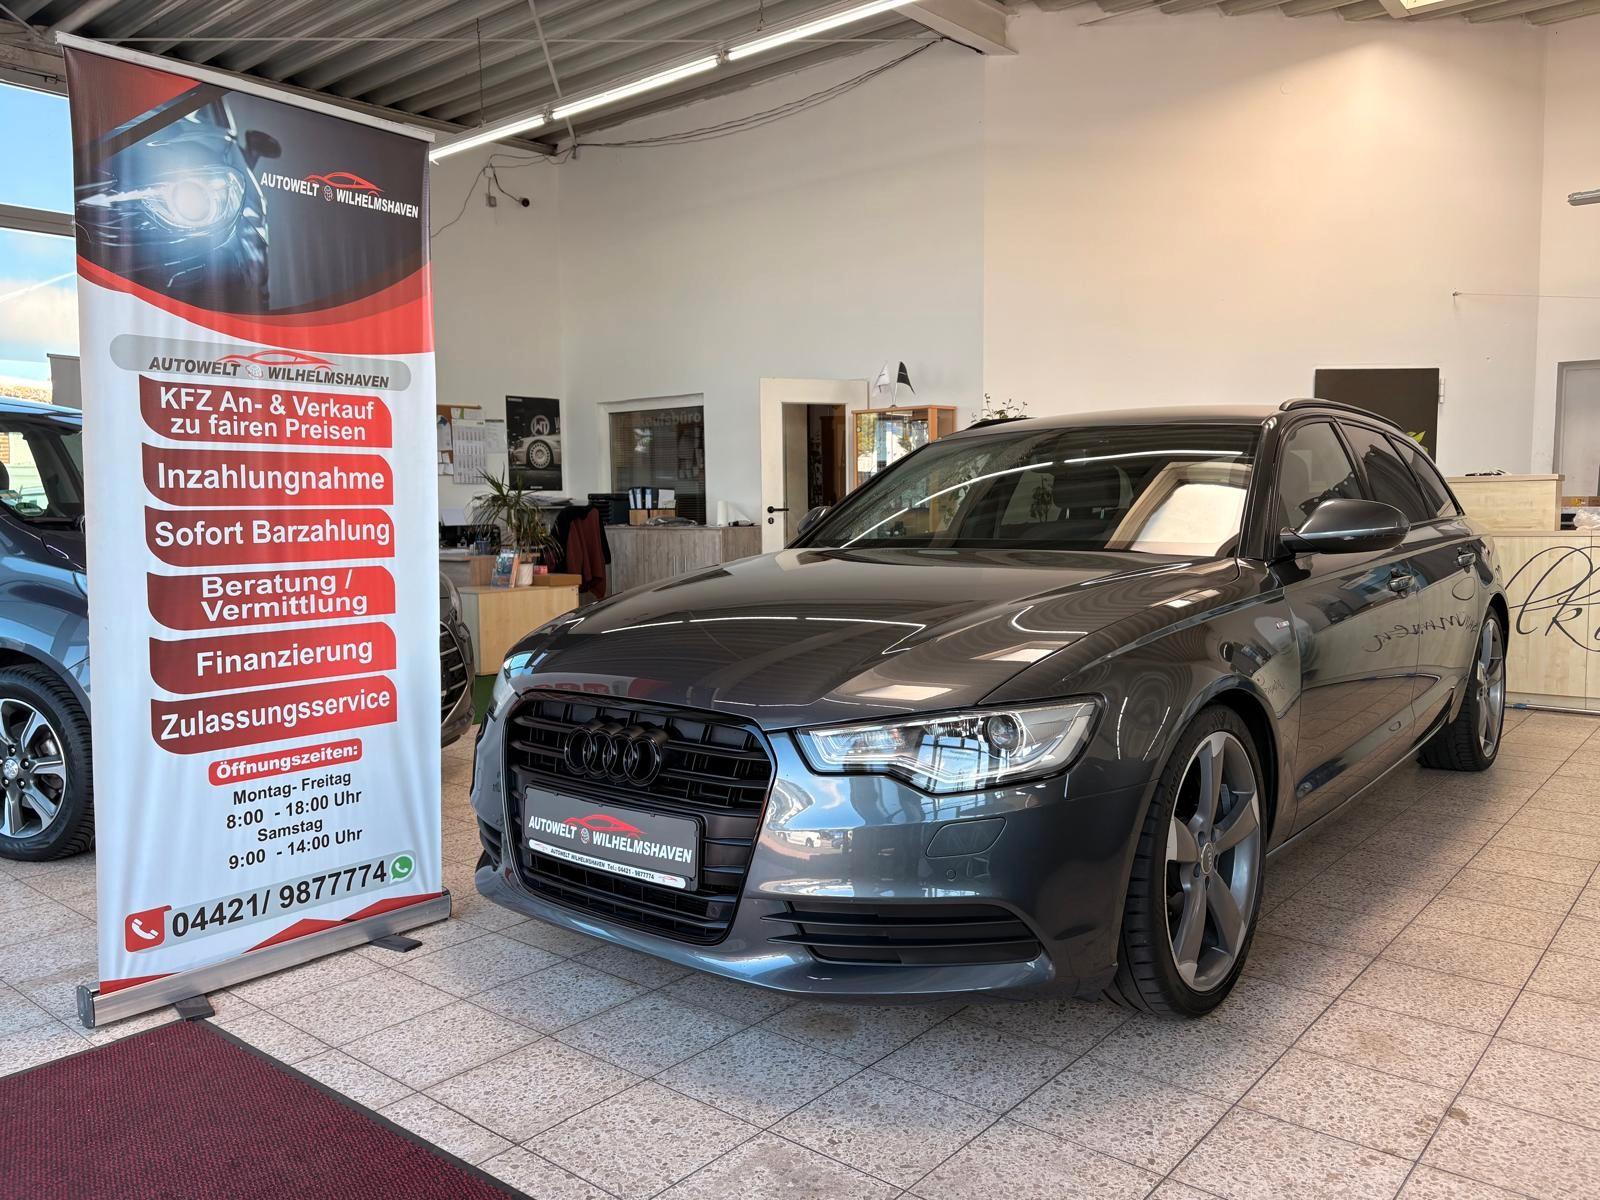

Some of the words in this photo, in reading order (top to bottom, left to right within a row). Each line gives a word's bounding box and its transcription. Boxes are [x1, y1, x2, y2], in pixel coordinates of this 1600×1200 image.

[260, 172, 319, 197] AUTOWELT
[336, 188, 419, 218] WILHELMSHAVEN
[149, 356, 240, 377] AUTOWELT
[268, 366, 389, 388] WILHELMSHAVEN
[160, 386, 213, 412] KFZ
[219, 391, 262, 414] An-
[269, 394, 286, 415] &
[292, 395, 374, 420] Verkauf
[170, 417, 200, 434] zu
[208, 414, 277, 437] fairen
[285, 418, 366, 441] Preisen
[158, 462, 385, 495] Inzahlungnahme
[155, 521, 244, 547] Sofort
[252, 519, 390, 545] Barzahlung
[202, 574, 336, 598] Beratung
[201, 594, 367, 622] Vermittlung
[196, 641, 372, 677] Finanzierung
[160, 688, 390, 741] Zulassungsservice
[216, 744, 358, 779] Öffnungszeiten:
[233, 785, 297, 805] Montag-
[301, 772, 351, 792] Freitag
[226, 808, 264, 829] 8:00
[285, 796, 329, 817] 18:00
[334, 789, 362, 808] Uhr
[257, 818, 323, 842] Samstag
[528, 815, 577, 839] AUTOWELT
[592, 831, 692, 863] WILHELMSHAVEN
[228, 849, 266, 870] 9:00
[287, 834, 330, 856] 14:00
[335, 827, 363, 845] Uhr
[550, 848, 570, 859] AUTOWELT
[571, 853, 606, 868] WILHELMSHAVEN
[618, 865, 631, 875] 04421
[279, 860, 387, 909] 9877774
